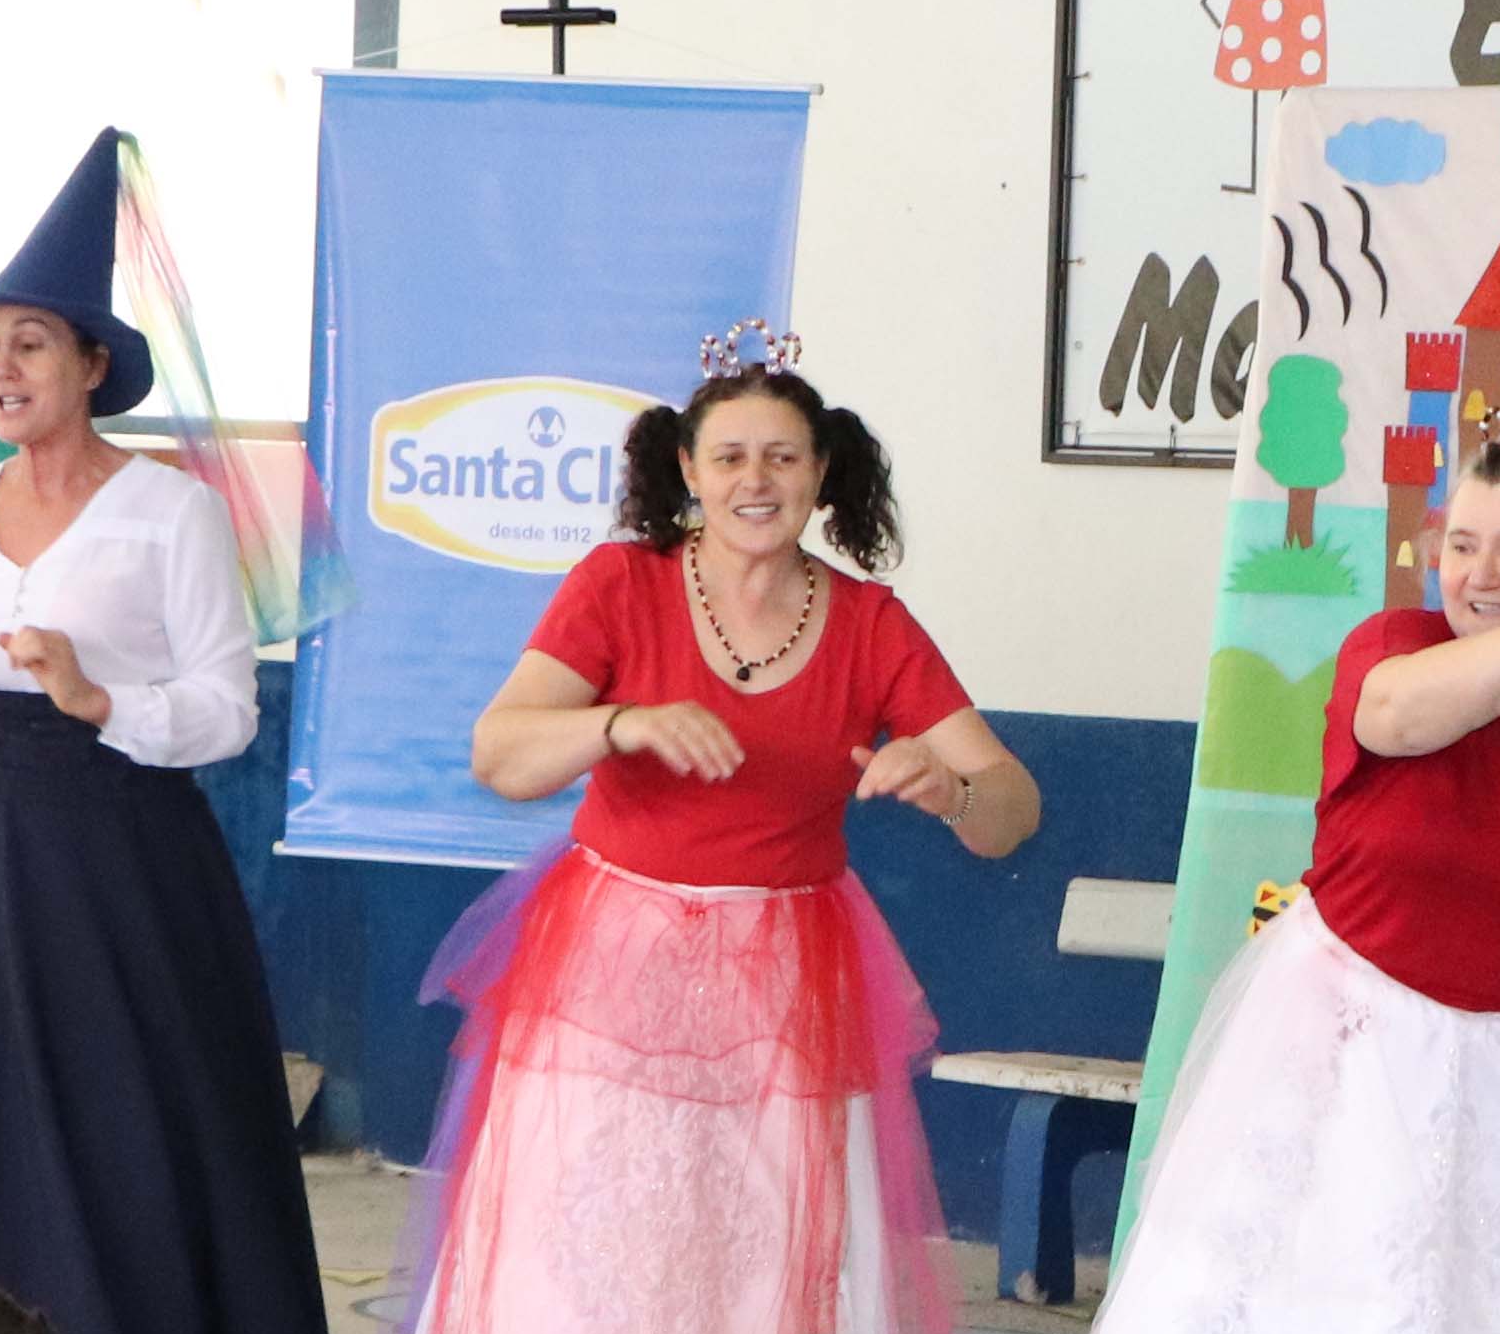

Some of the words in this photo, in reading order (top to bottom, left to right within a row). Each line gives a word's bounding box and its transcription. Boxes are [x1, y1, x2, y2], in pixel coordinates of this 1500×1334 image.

[388, 438, 545, 502] Santa
[556, 444, 624, 506] Cl
[489, 521, 545, 542] desde
[551, 523, 592, 544] 1912
